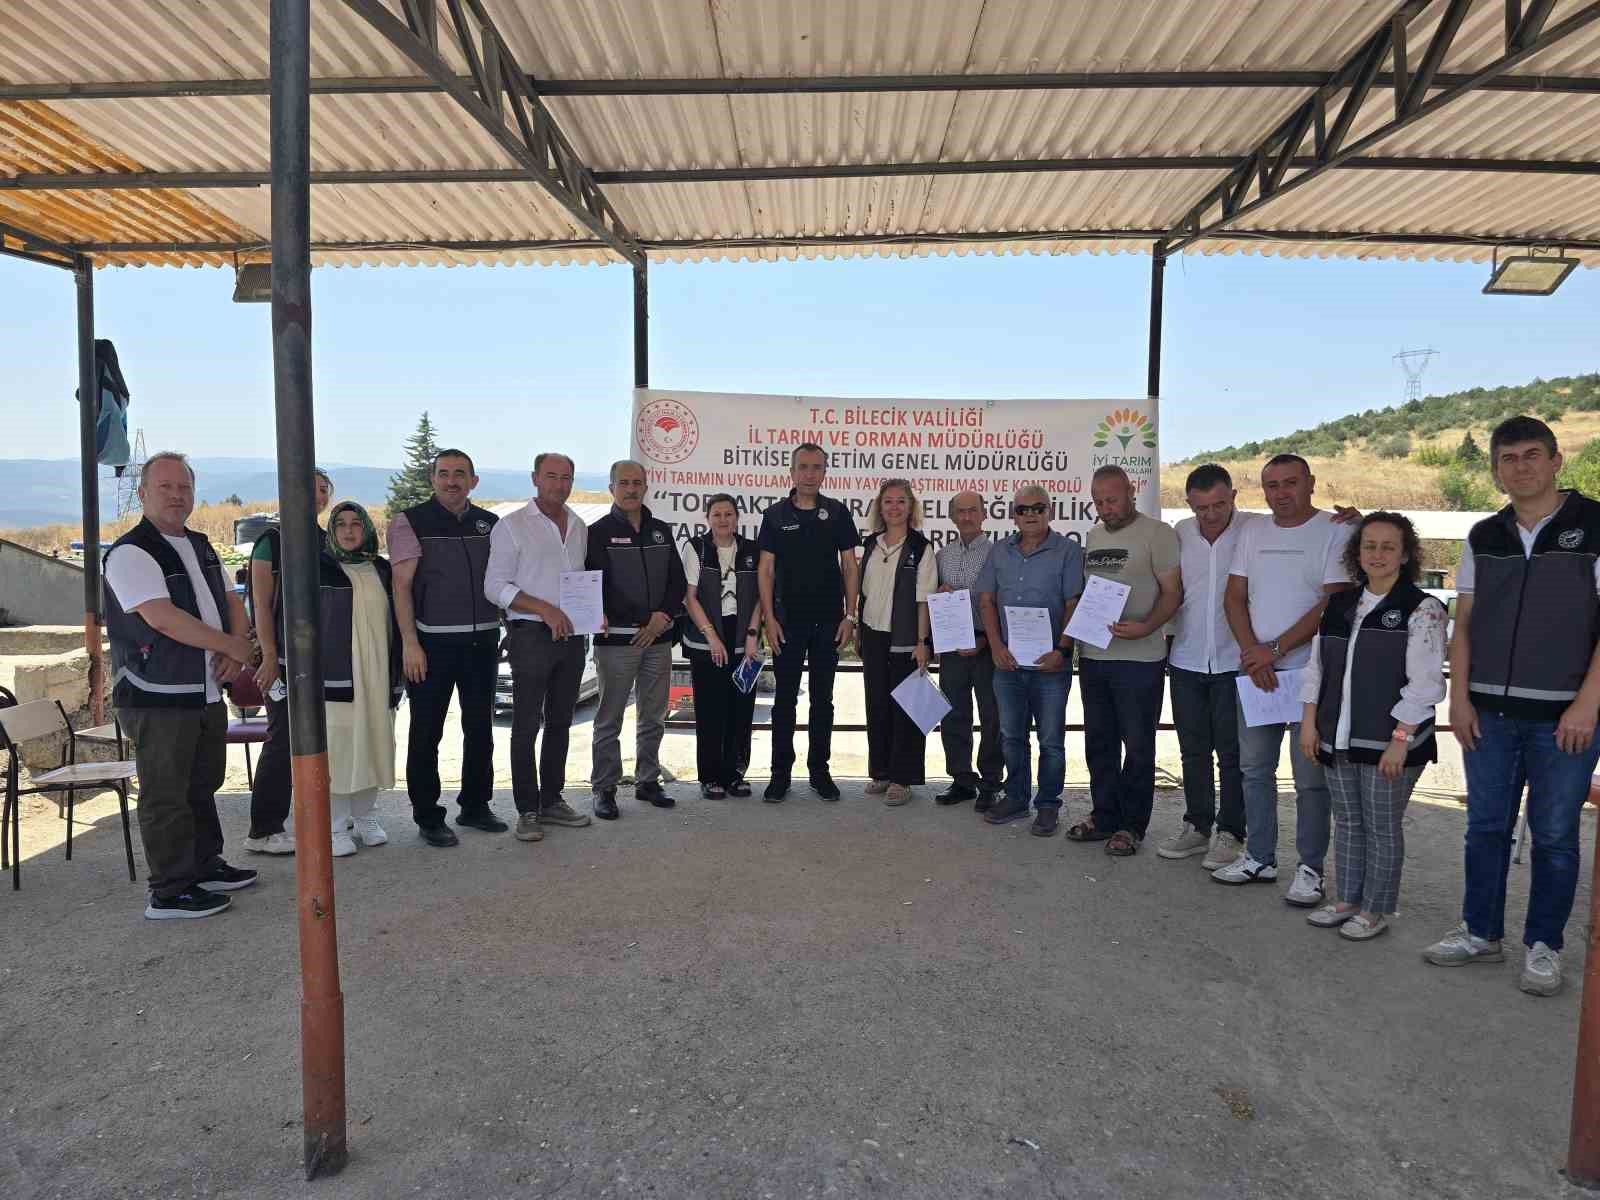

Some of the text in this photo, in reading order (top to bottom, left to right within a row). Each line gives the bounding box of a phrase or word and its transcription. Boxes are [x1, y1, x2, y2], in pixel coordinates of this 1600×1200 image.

[809, 406, 983, 427] T.C. BİLECİK VALİLİĞİ
[749, 424, 1043, 449] İL TARIM VE ORMAN MÜDÜRLÜĞÜ
[724, 445, 790, 467] BİTKİSE
[881, 453, 939, 470] GENEL
[945, 450, 1068, 471] MÜDÜRLÜĞÜ
[1112, 456, 1152, 467] TARIM
[671, 471, 724, 485] TARIMIN
[992, 480, 1008, 492] VE
